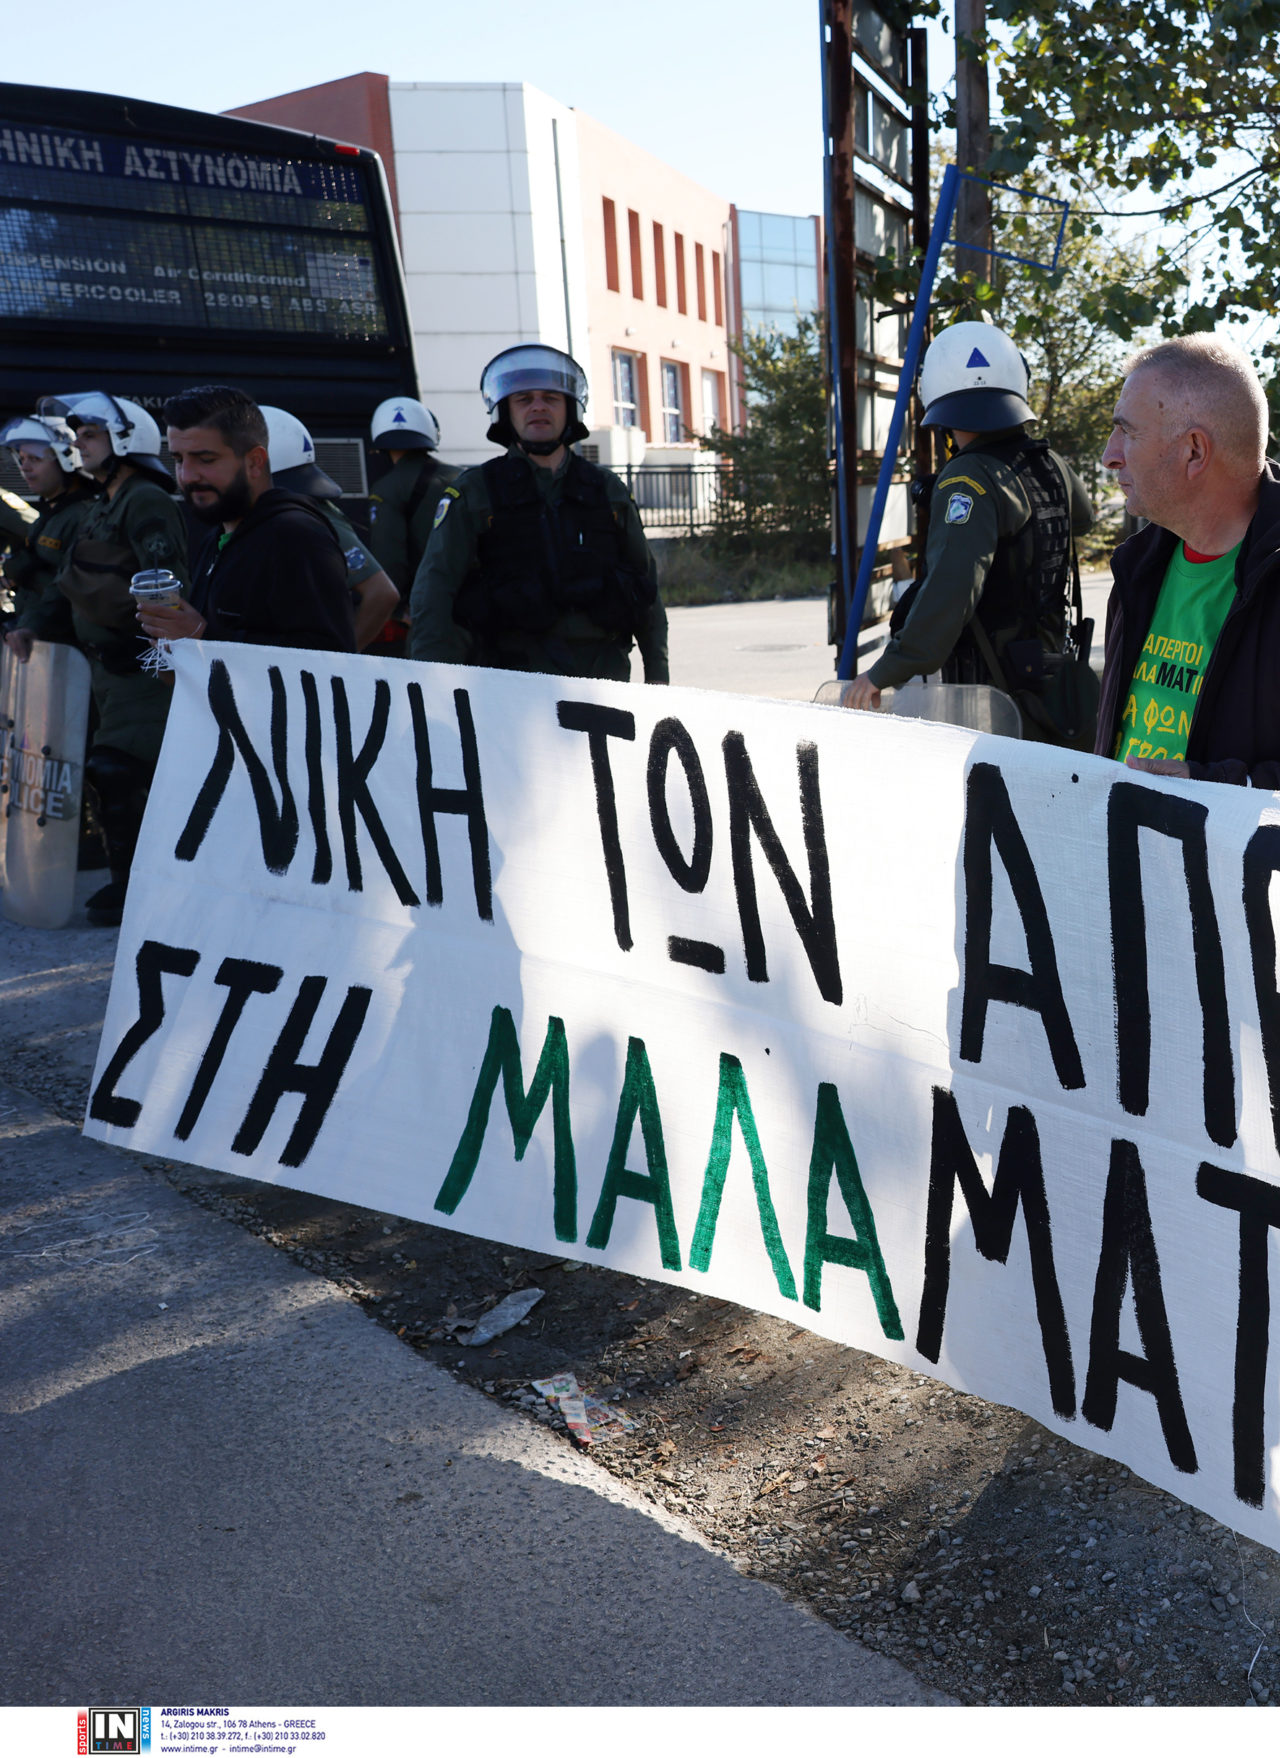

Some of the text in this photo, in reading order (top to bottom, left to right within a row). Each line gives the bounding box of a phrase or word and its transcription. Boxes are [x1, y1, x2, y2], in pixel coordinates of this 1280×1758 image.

[124, 145, 303, 195] ΑΣΤΥΝΟΜΙΑ
[1143, 633, 1203, 666] ΑΠΕΡΓΟΙ
[1133, 661, 1203, 696] ΛΑΜΑΤΙ
[174, 658, 495, 925] ΝΙΚΗ
[90, 940, 373, 1168] ΣΤΗ
